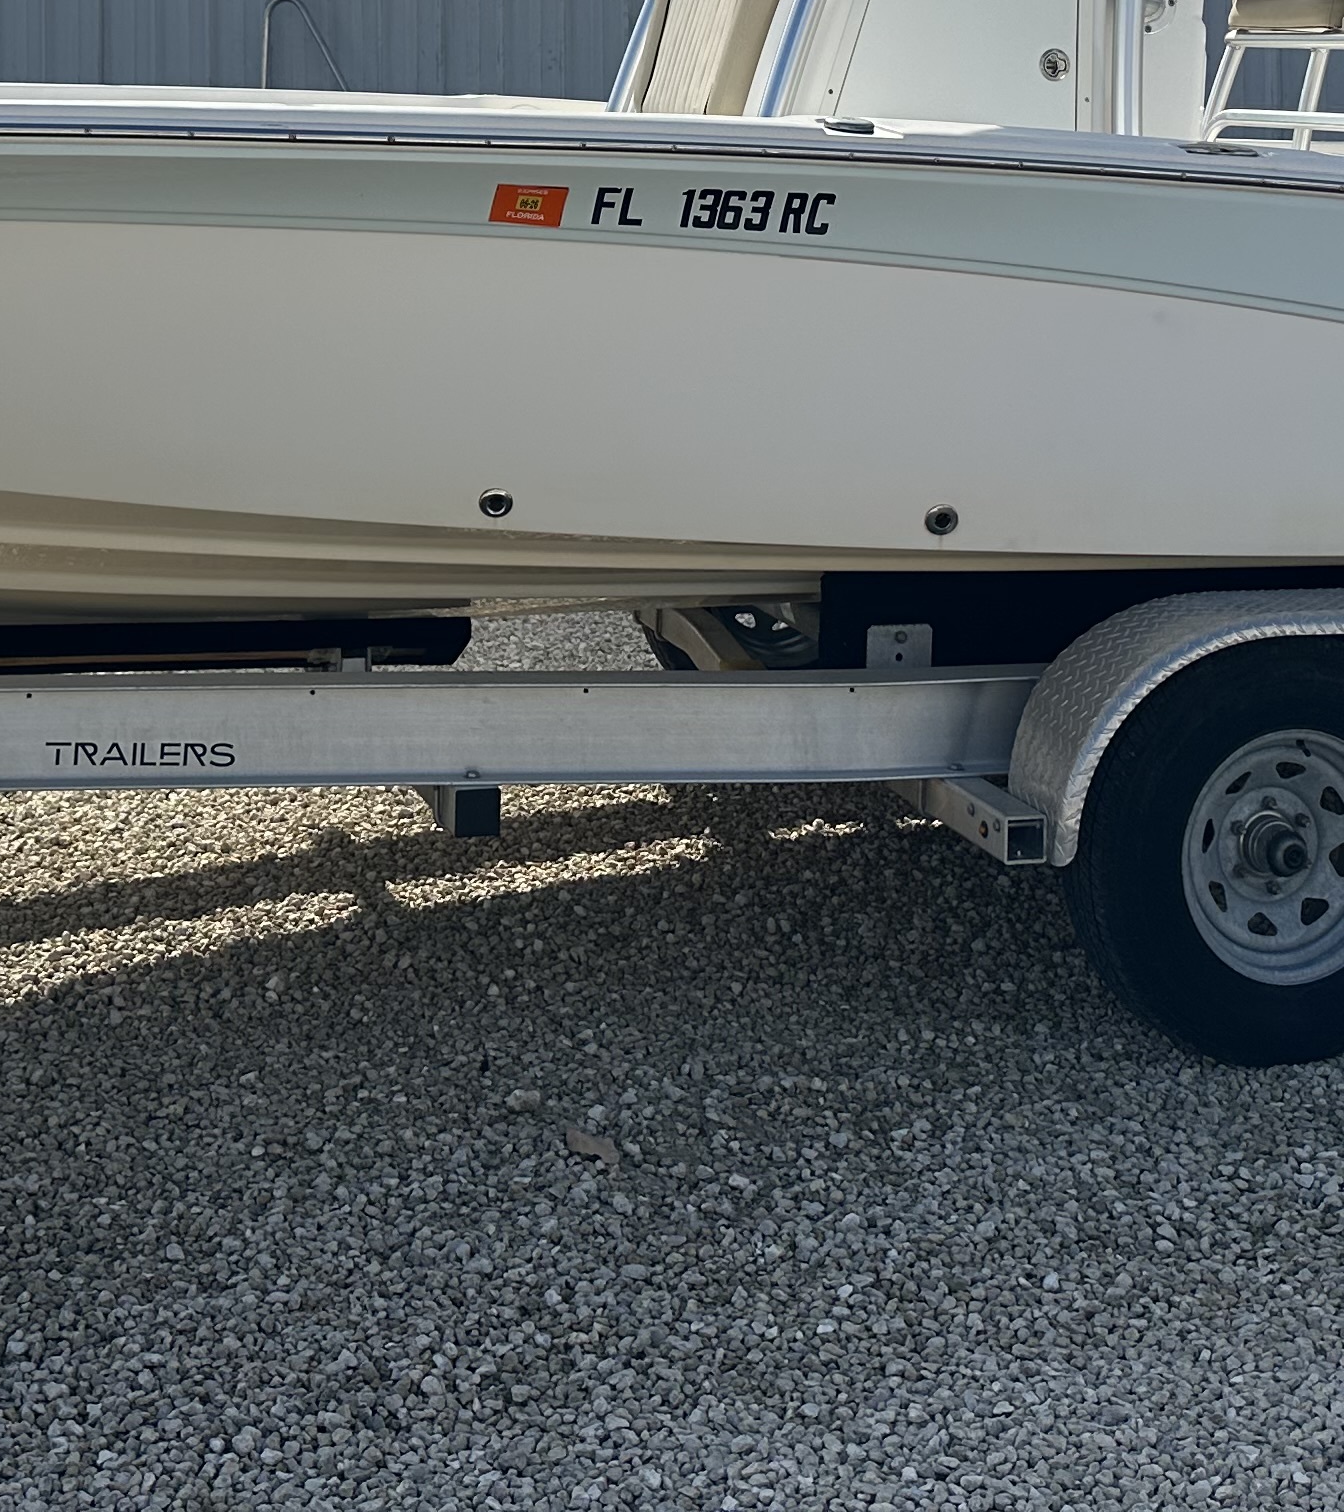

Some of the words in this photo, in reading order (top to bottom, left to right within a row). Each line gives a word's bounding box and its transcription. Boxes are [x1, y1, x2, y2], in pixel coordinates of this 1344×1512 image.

[505, 210, 545, 221] FLORIDA
[591, 187, 643, 227] FL
[680, 188, 773, 232] 1363
[778, 192, 837, 235] RC
[44, 740, 238, 768] TRAILERS
